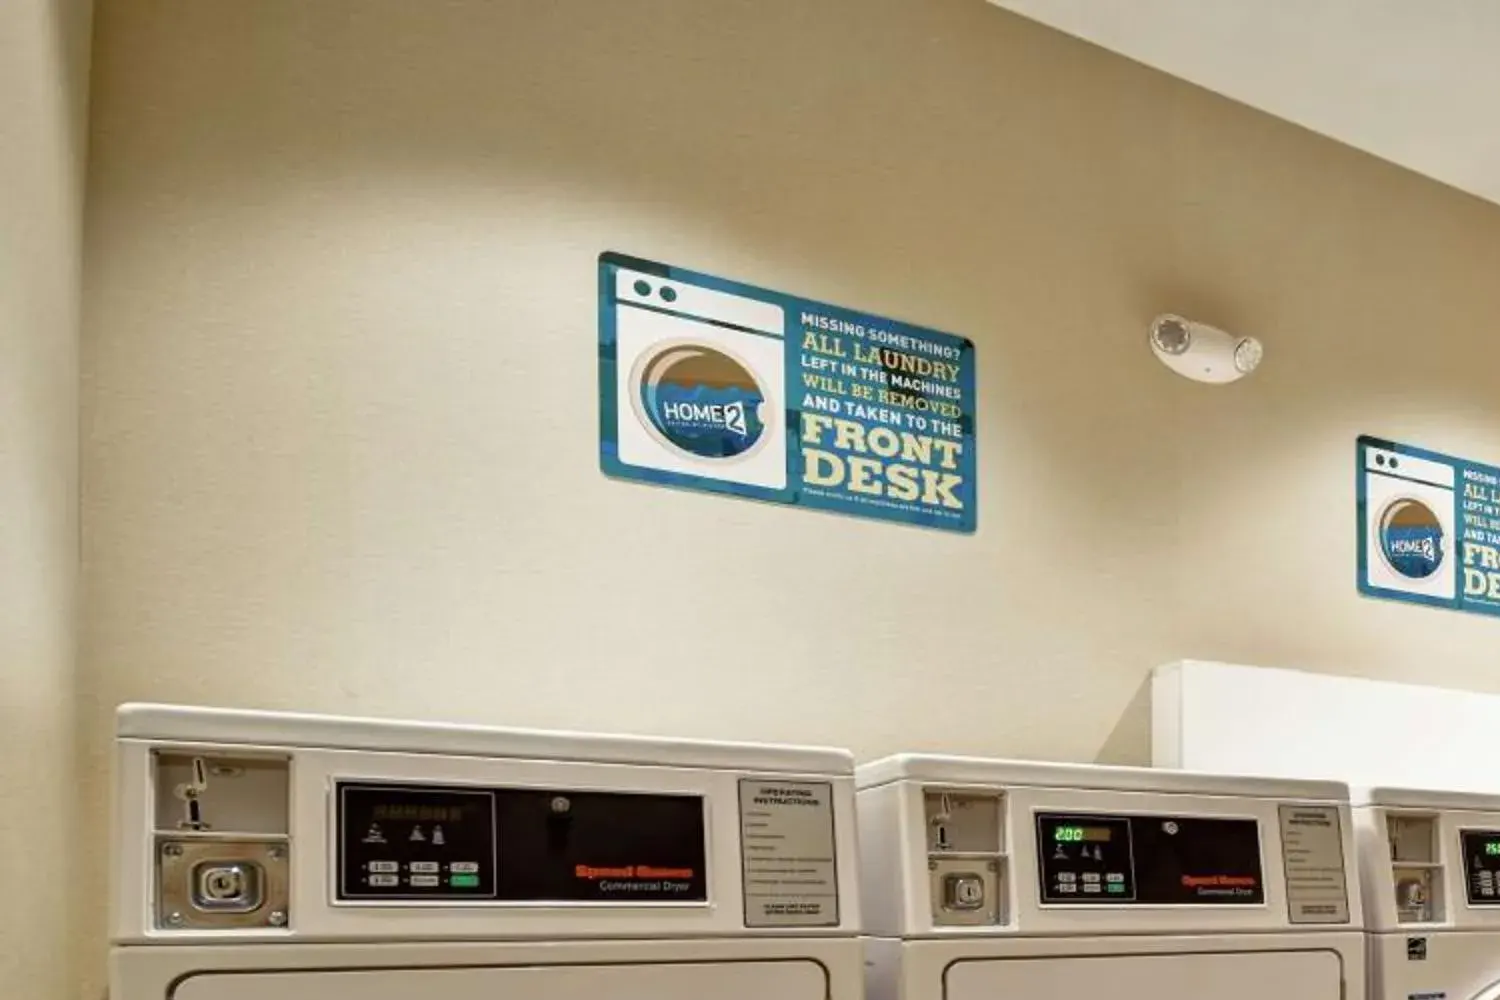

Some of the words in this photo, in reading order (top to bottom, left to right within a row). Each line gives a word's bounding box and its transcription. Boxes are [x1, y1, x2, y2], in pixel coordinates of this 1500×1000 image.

[801, 312, 865, 337] MISSING
[868, 328, 961, 360] SOMETHING?
[802, 331, 847, 358] ALL
[854, 342, 961, 383] LAUNDRY
[801, 354, 840, 373] LEFT
[841, 365, 857, 377] IN
[860, 367, 888, 384] THE
[891, 374, 961, 400] MACHINES
[803, 372, 848, 395] WILL
[852, 383, 874, 400] BE
[878, 389, 962, 419] REMOVED
[802, 393, 840, 413] AND
[845, 402, 902, 426] TAKEN
[905, 414, 927, 431] TO
[932, 420, 963, 438] THE
[802, 412, 963, 469] FRONT
[802, 448, 964, 510] DESK
[1463, 483, 1488, 501] ALL
[1463, 528, 1485, 541] AND
